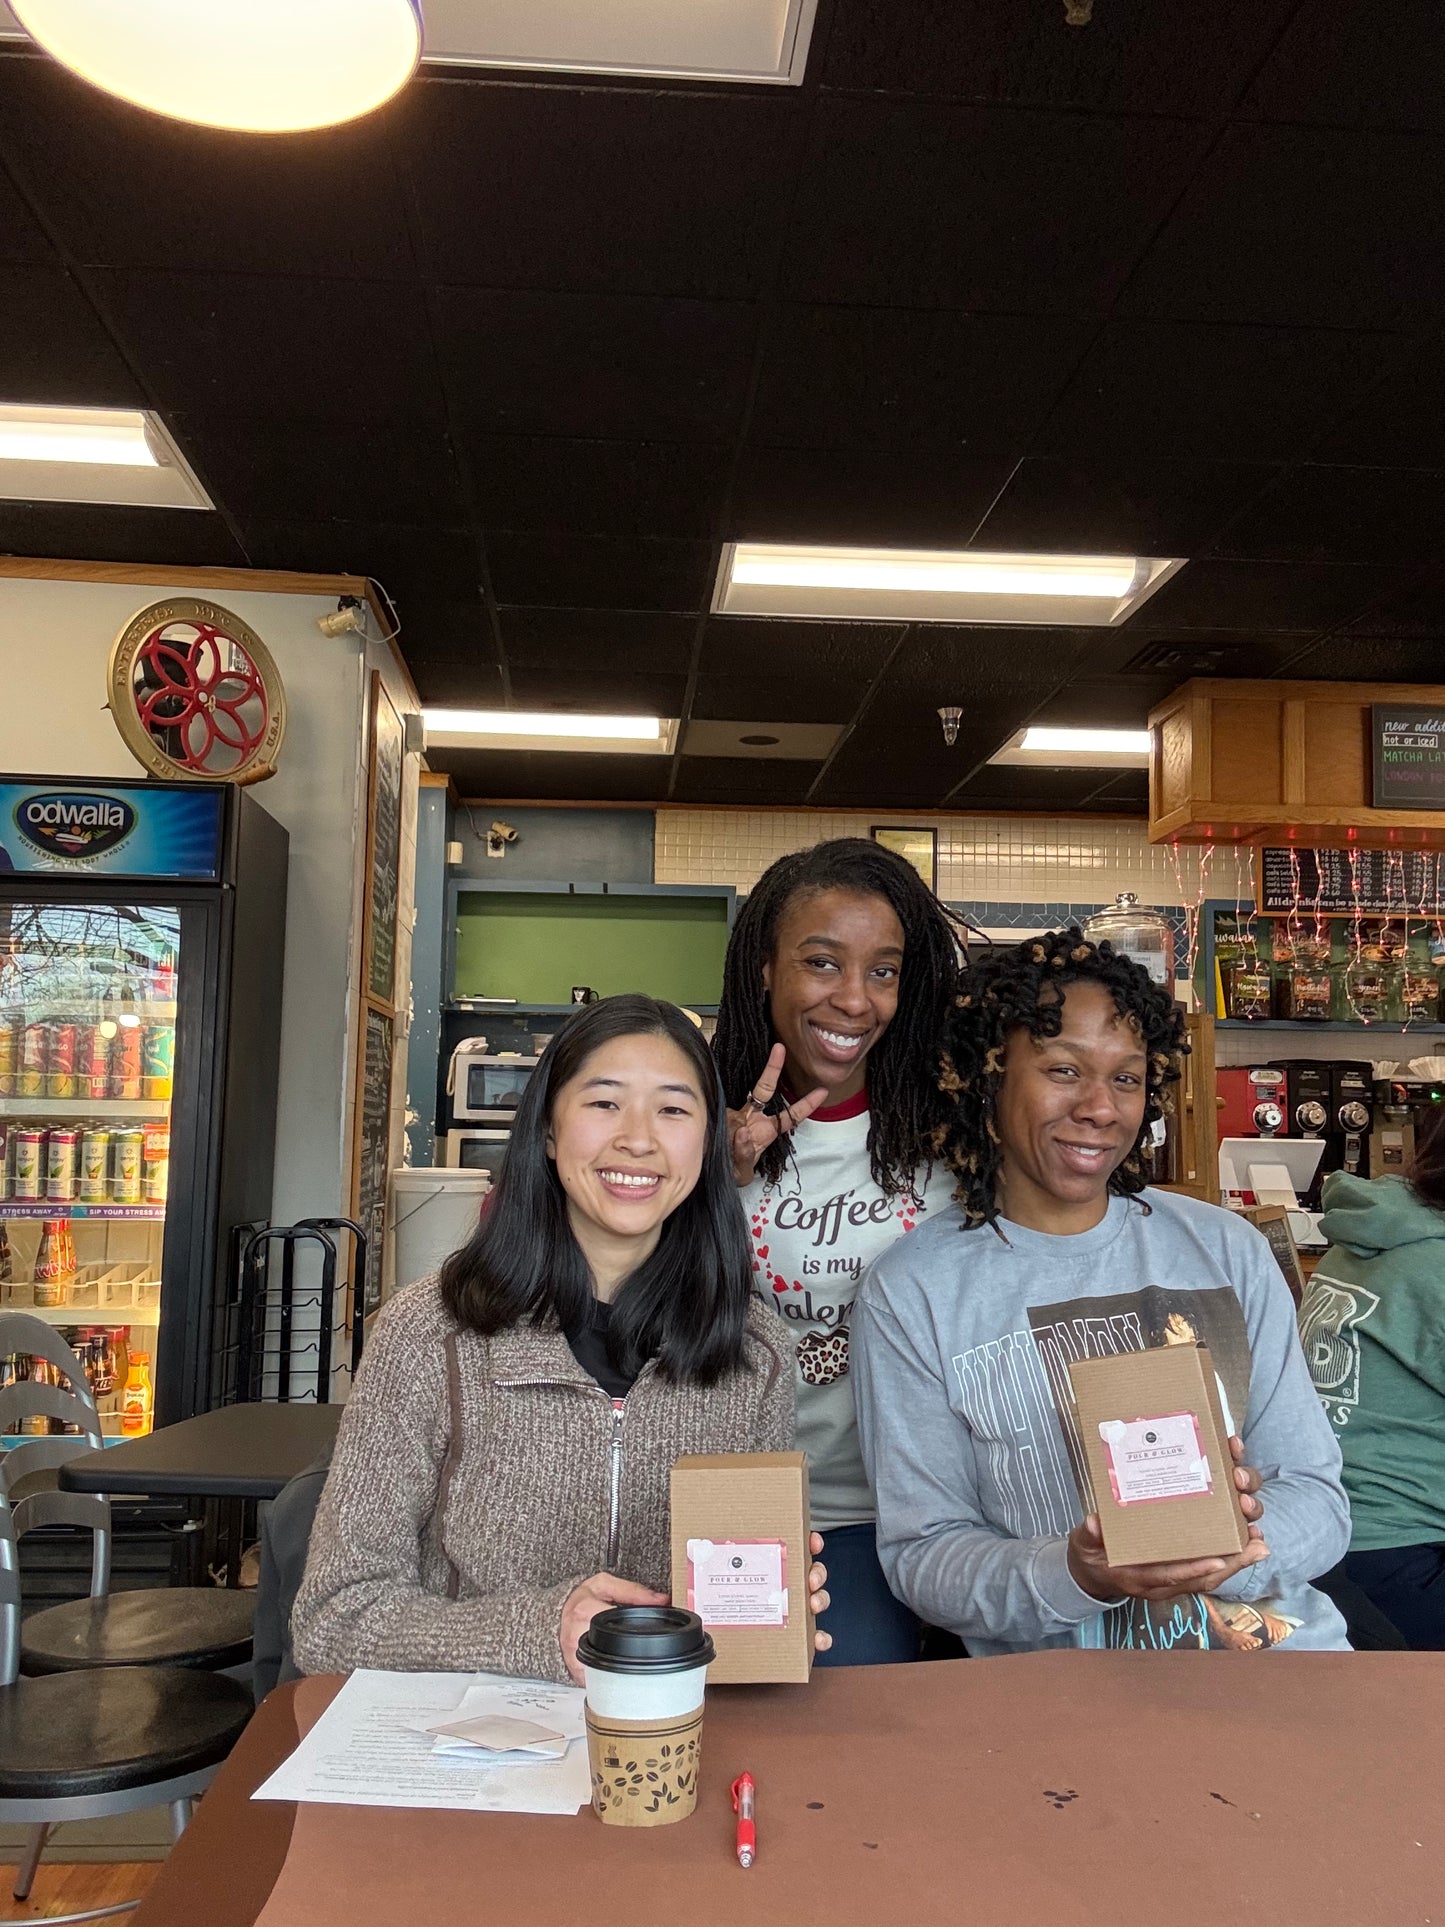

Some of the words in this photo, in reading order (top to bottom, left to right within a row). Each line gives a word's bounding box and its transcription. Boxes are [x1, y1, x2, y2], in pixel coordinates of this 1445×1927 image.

[1385, 721, 1409, 732] new
[1403, 737, 1414, 745] or
[1383, 750, 1423, 762] MATCHA
[26, 799, 125, 826] odwalla
[1267, 897, 1281, 906] All
[774, 1189, 894, 1247] Coffee
[802, 1254, 821, 1275] is
[827, 1257, 865, 1281] my
